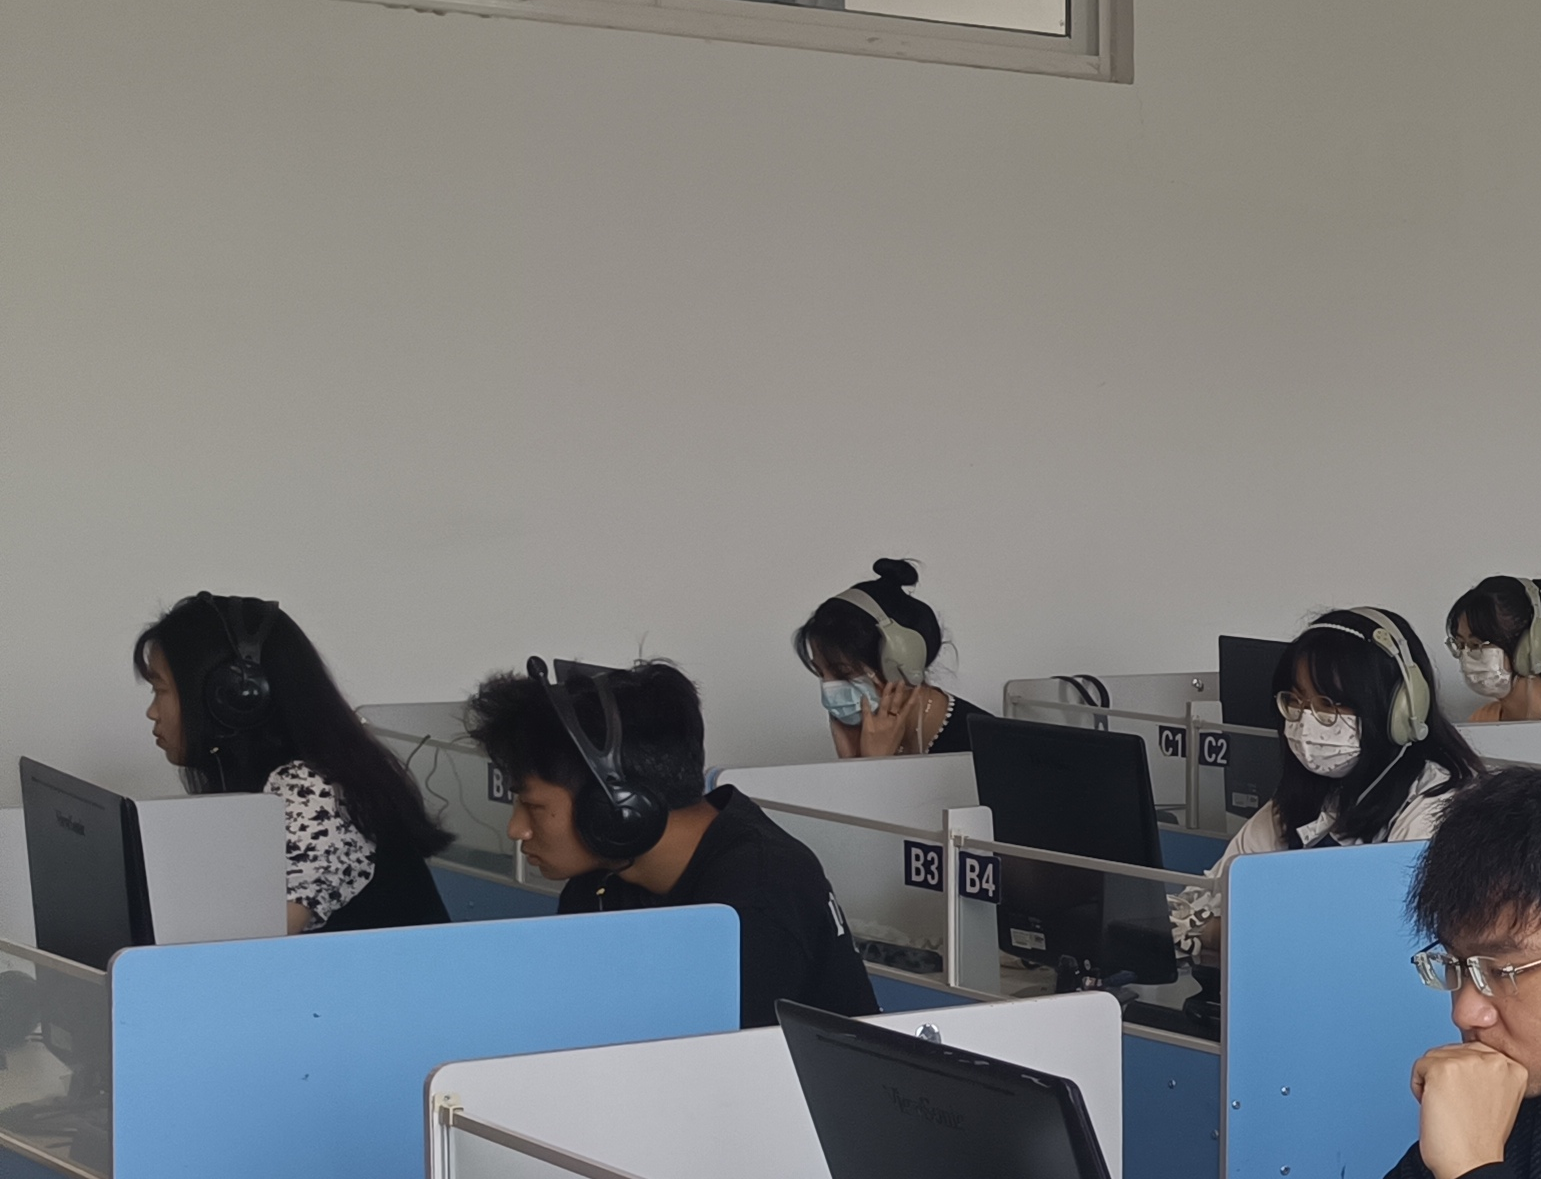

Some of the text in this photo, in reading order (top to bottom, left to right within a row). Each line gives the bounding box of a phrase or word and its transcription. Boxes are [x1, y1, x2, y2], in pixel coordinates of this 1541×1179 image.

[1162, 729, 1183, 754] C1
[1204, 736, 1228, 761] C2
[493, 768, 512, 801] B
[911, 847, 940, 885] B3
[965, 857, 996, 898] B4
